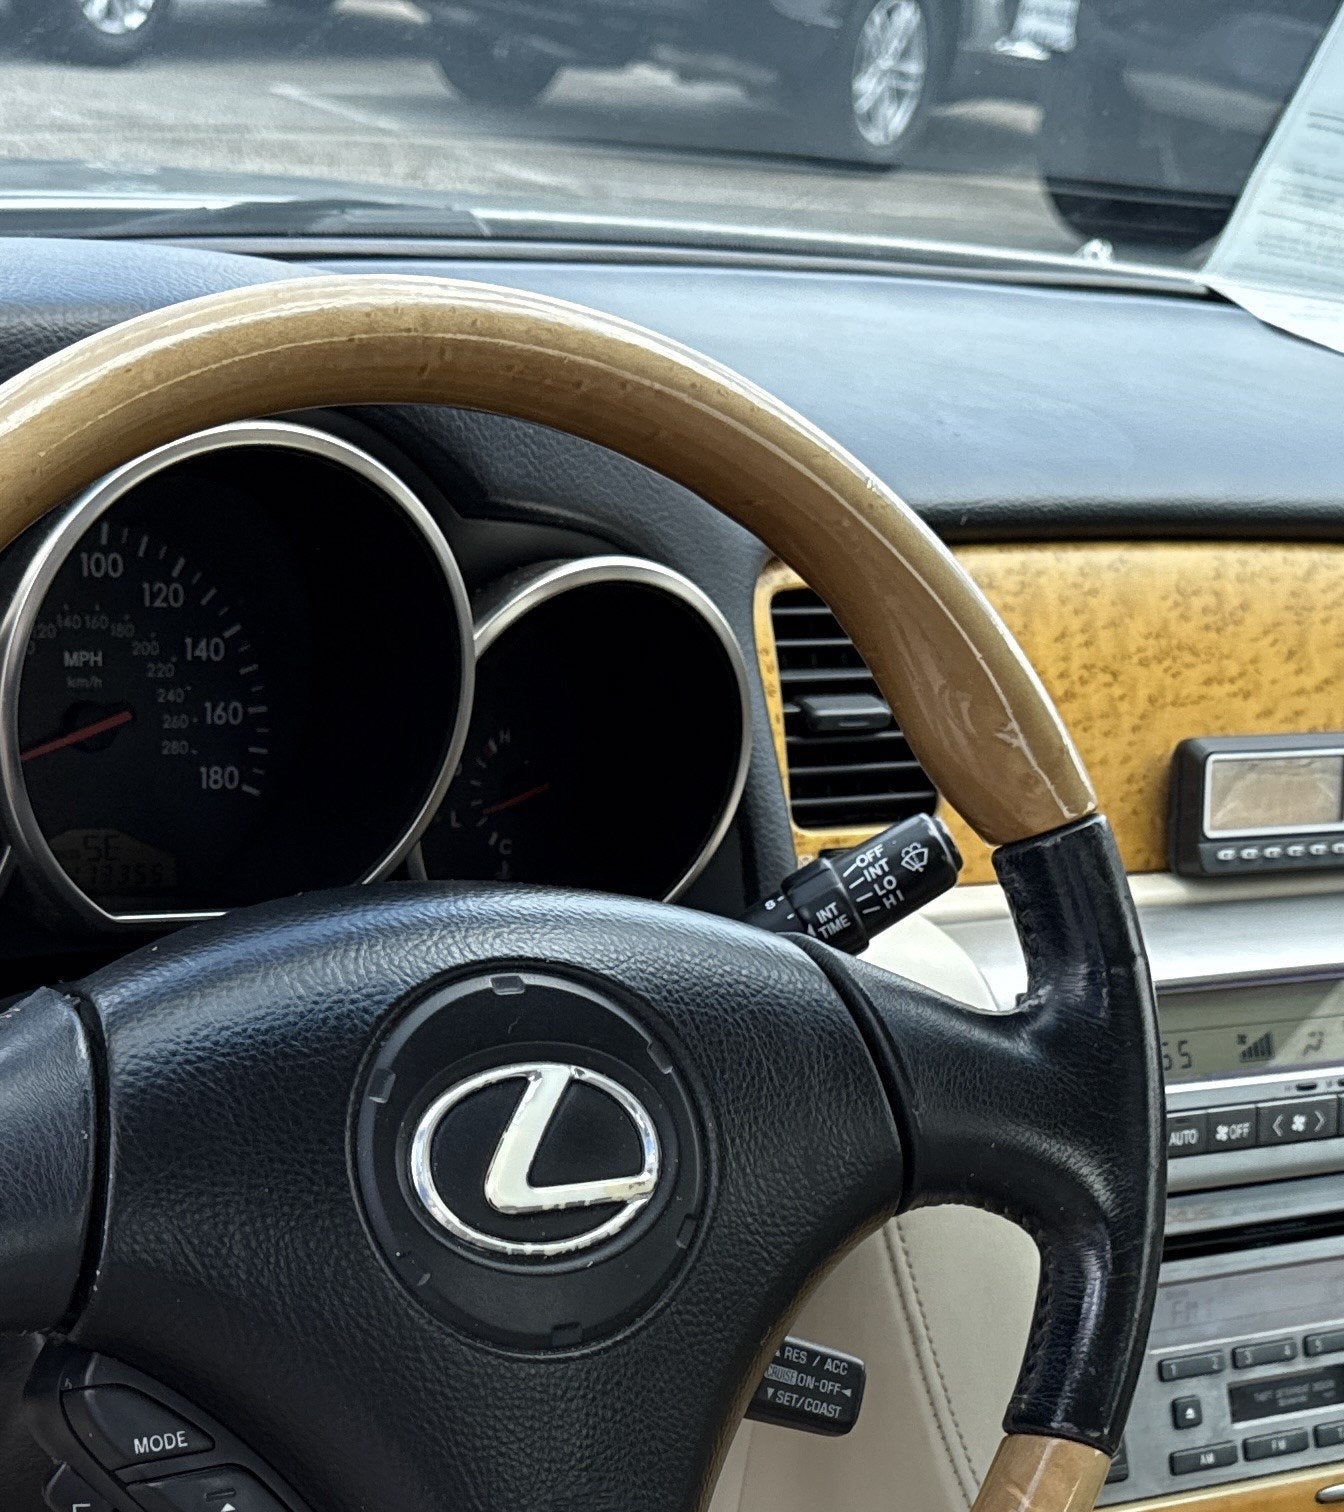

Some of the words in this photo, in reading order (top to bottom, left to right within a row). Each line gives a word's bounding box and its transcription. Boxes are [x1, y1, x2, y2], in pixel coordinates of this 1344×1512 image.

[80, 551, 125, 578] 100
[142, 581, 185, 608] 120
[84, 614, 110, 630] 160
[63, 650, 103, 668] MPH
[184, 637, 226, 662] 140
[146, 663, 176, 678] 220
[66, 675, 103, 689] km/h
[157, 688, 185, 703] 240
[204, 701, 244, 726] 160
[200, 765, 240, 790] 180
[855, 844, 885, 868] OFF
[862, 857, 890, 882] INT
[873, 875, 897, 897] LO
[883, 889, 905, 910] HI
[815, 901, 840, 923] INT
[817, 913, 851, 939] TIME
[1168, 1129, 1200, 1146] AUTO
[1229, 1123, 1251, 1140] OFF
[783, 1346, 808, 1364] RES
[824, 1358, 849, 1376] ACC
[1210, 1356, 1220, 1370] 2
[1244, 1350, 1253, 1364] 3
[797, 1373, 842, 1396] ON-OFF
[775, 1390, 843, 1419] SET/COAST
[133, 1430, 189, 1455] MODE
[1271, 1439, 1286, 1453] FM
[1199, 1452, 1215, 1466] AM
